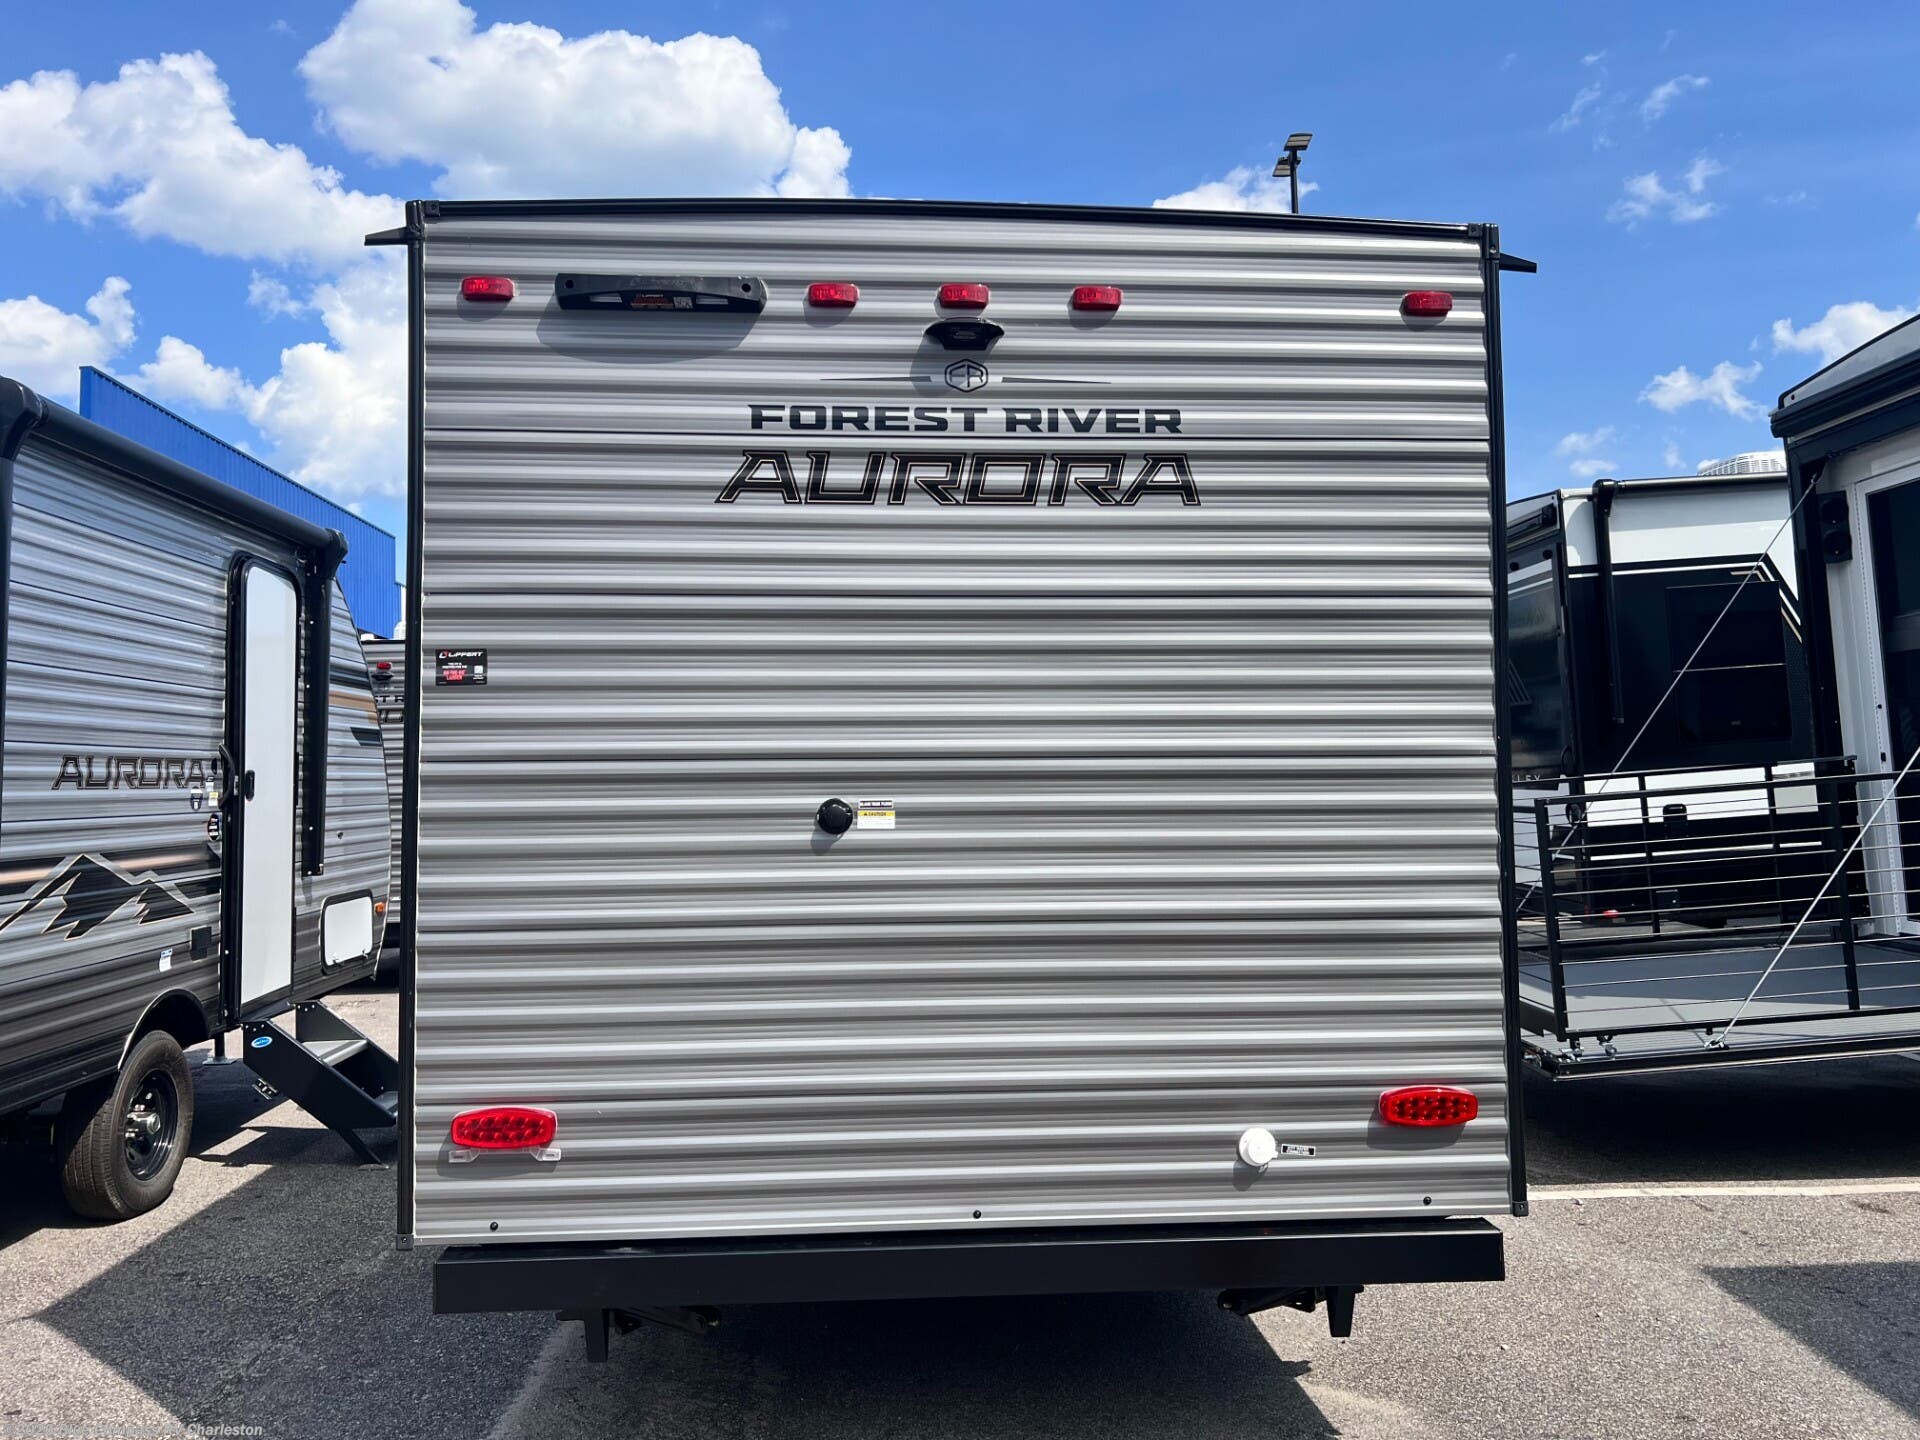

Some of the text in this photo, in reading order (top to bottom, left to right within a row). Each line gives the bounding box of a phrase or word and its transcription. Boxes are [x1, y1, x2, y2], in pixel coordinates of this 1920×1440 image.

[747, 404, 1183, 434] FOREST RIVER
[714, 449, 1202, 506] AURORA
[51, 755, 205, 790] AURORA
